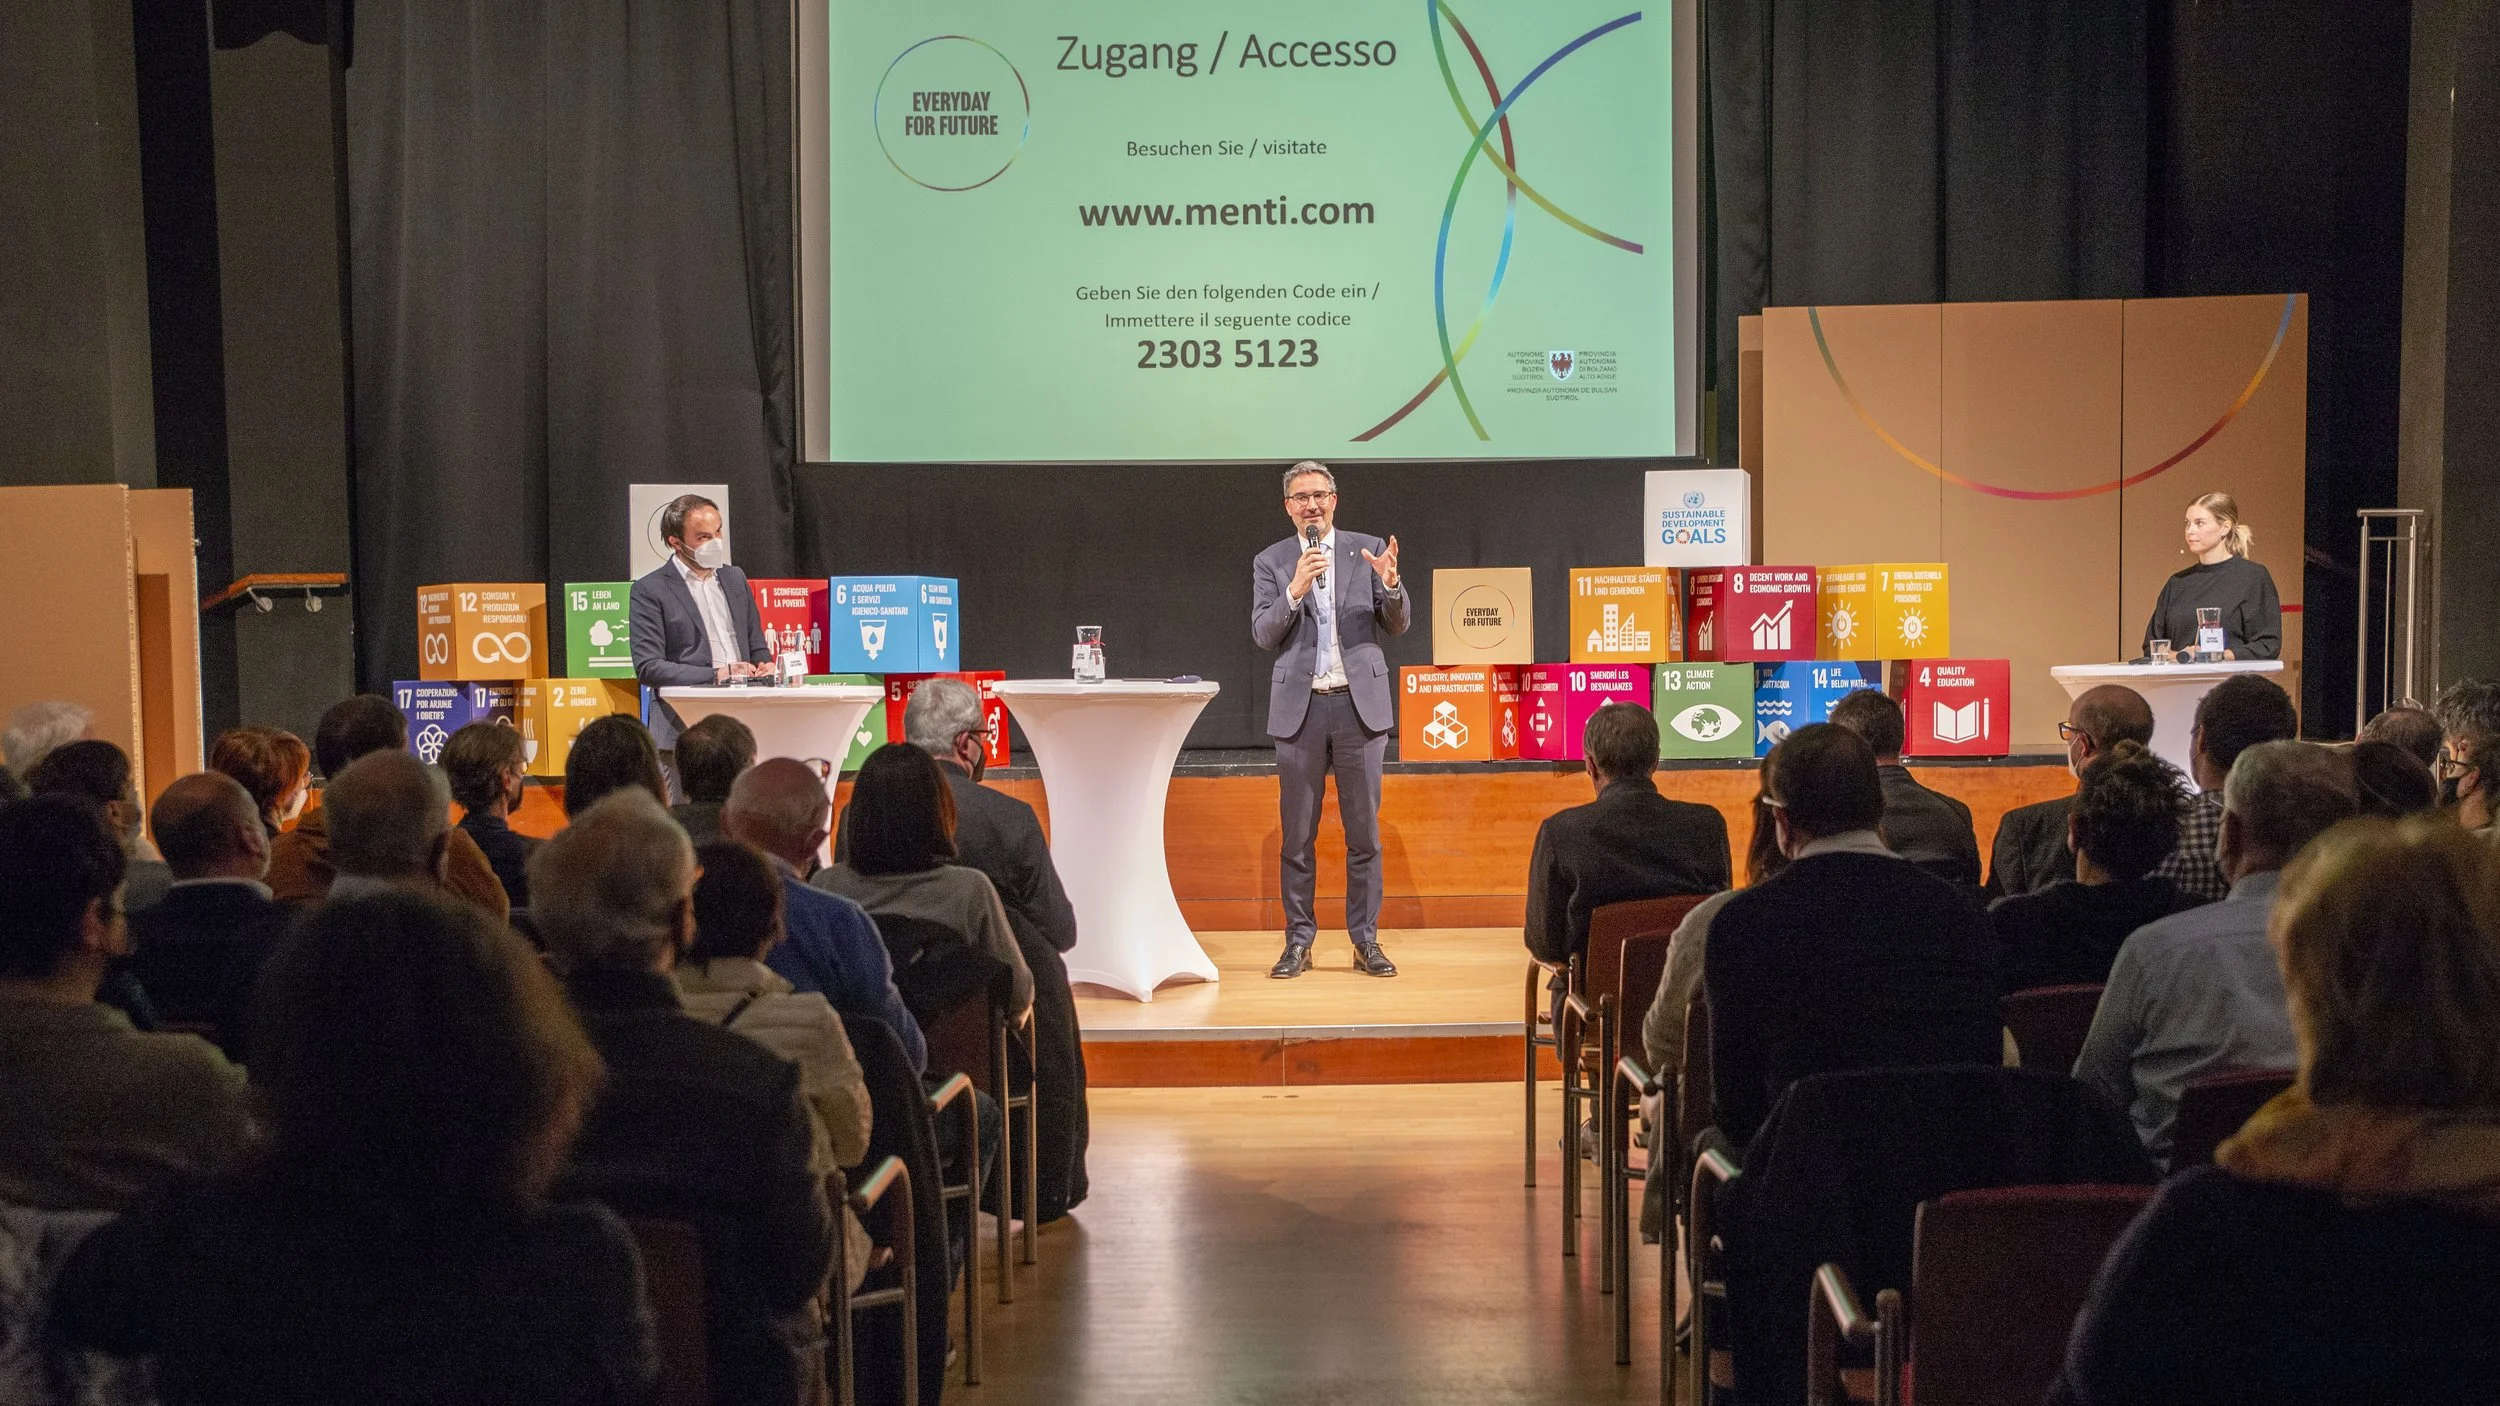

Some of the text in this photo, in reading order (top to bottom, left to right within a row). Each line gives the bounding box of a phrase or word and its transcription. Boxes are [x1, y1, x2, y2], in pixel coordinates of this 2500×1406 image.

[1056, 30, 1397, 78] Zugang / Accesso
[912, 91, 991, 112] EVERYDAY
[905, 115, 999, 136] FOR FUTURE
[1126, 138, 1327, 159] Besuchen Sie / visitate
[1078, 195, 1375, 227] www.menti.com
[1075, 282, 1380, 303] Geben Sie den folgenden Code ein /
[1104, 311, 1351, 331] Immettere il seguente codice
[1136, 339, 1319, 369] 2303 5123
[1662, 510, 1726, 519] SUSTAINABLE
[1662, 519, 1725, 528] DEVELOPMENT
[1661, 528, 1726, 545] GOALS
[1594, 573, 1662, 585] NACHHALTIGE STÄDTE
[1733, 573, 1744, 593] 8
[1749, 573, 1808, 582] DECENT WORK AND
[1880, 571, 1889, 592] 7
[773, 587, 809, 596] SCONFIGGERE
[852, 583, 897, 594] ACQUA PULITA
[1576, 576, 1592, 596] 11
[1594, 586, 1645, 596] UND GEMEINDEN
[1749, 584, 1811, 593] ECONOMIC GROWTH
[481, 591, 516, 600] CONSUM Y
[592, 590, 612, 599] LEBEN
[760, 587, 768, 608] 1
[836, 584, 847, 605] 6
[921, 583, 927, 604] 6
[459, 592, 478, 612] 12
[570, 591, 588, 611] 15
[774, 597, 806, 608] LA POVERTÀ
[852, 595, 881, 604] E SERVIZI
[482, 603, 520, 612] PRODUZIUN
[592, 602, 620, 611] AN LAND
[851, 606, 909, 616] IGIENICO-SANITARI
[1466, 607, 1499, 616] EVERYDAY
[1463, 617, 1502, 627] FOR FUTURE
[1590, 669, 1629, 679] SMENDRÍ LES
[1686, 670, 1714, 679] CLIMATE
[1831, 668, 1841, 677] LIFE
[1937, 666, 1966, 676] QUALITY
[1419, 672, 1485, 682] INDUSTRY, INNOVATION
[1492, 672, 1498, 692] 9
[1522, 672, 1531, 692] 10
[1569, 671, 1587, 692] 10
[1662, 670, 1682, 691] 13
[1812, 668, 1828, 689] 14
[1919, 667, 1931, 687] 4
[1937, 678, 1975, 687] EDUCATION
[1406, 673, 1417, 694] 9
[1419, 683, 1485, 693] AND INFRASTRUCTURE
[1590, 682, 1633, 691] DESVALIANZES
[1686, 681, 1711, 690] ACTION
[1831, 679, 1849, 688] BELOW
[416, 688, 458, 698] COOPERAZIUNS
[569, 686, 587, 695] ZERO
[891, 681, 901, 701] 5
[397, 688, 412, 709] 17
[474, 687, 487, 708] 17
[552, 687, 565, 707] 2
[570, 698, 598, 707] HUNGER
[416, 699, 453, 709] POR ARJUNJE
[420, 711, 445, 720] OBIETIFS
